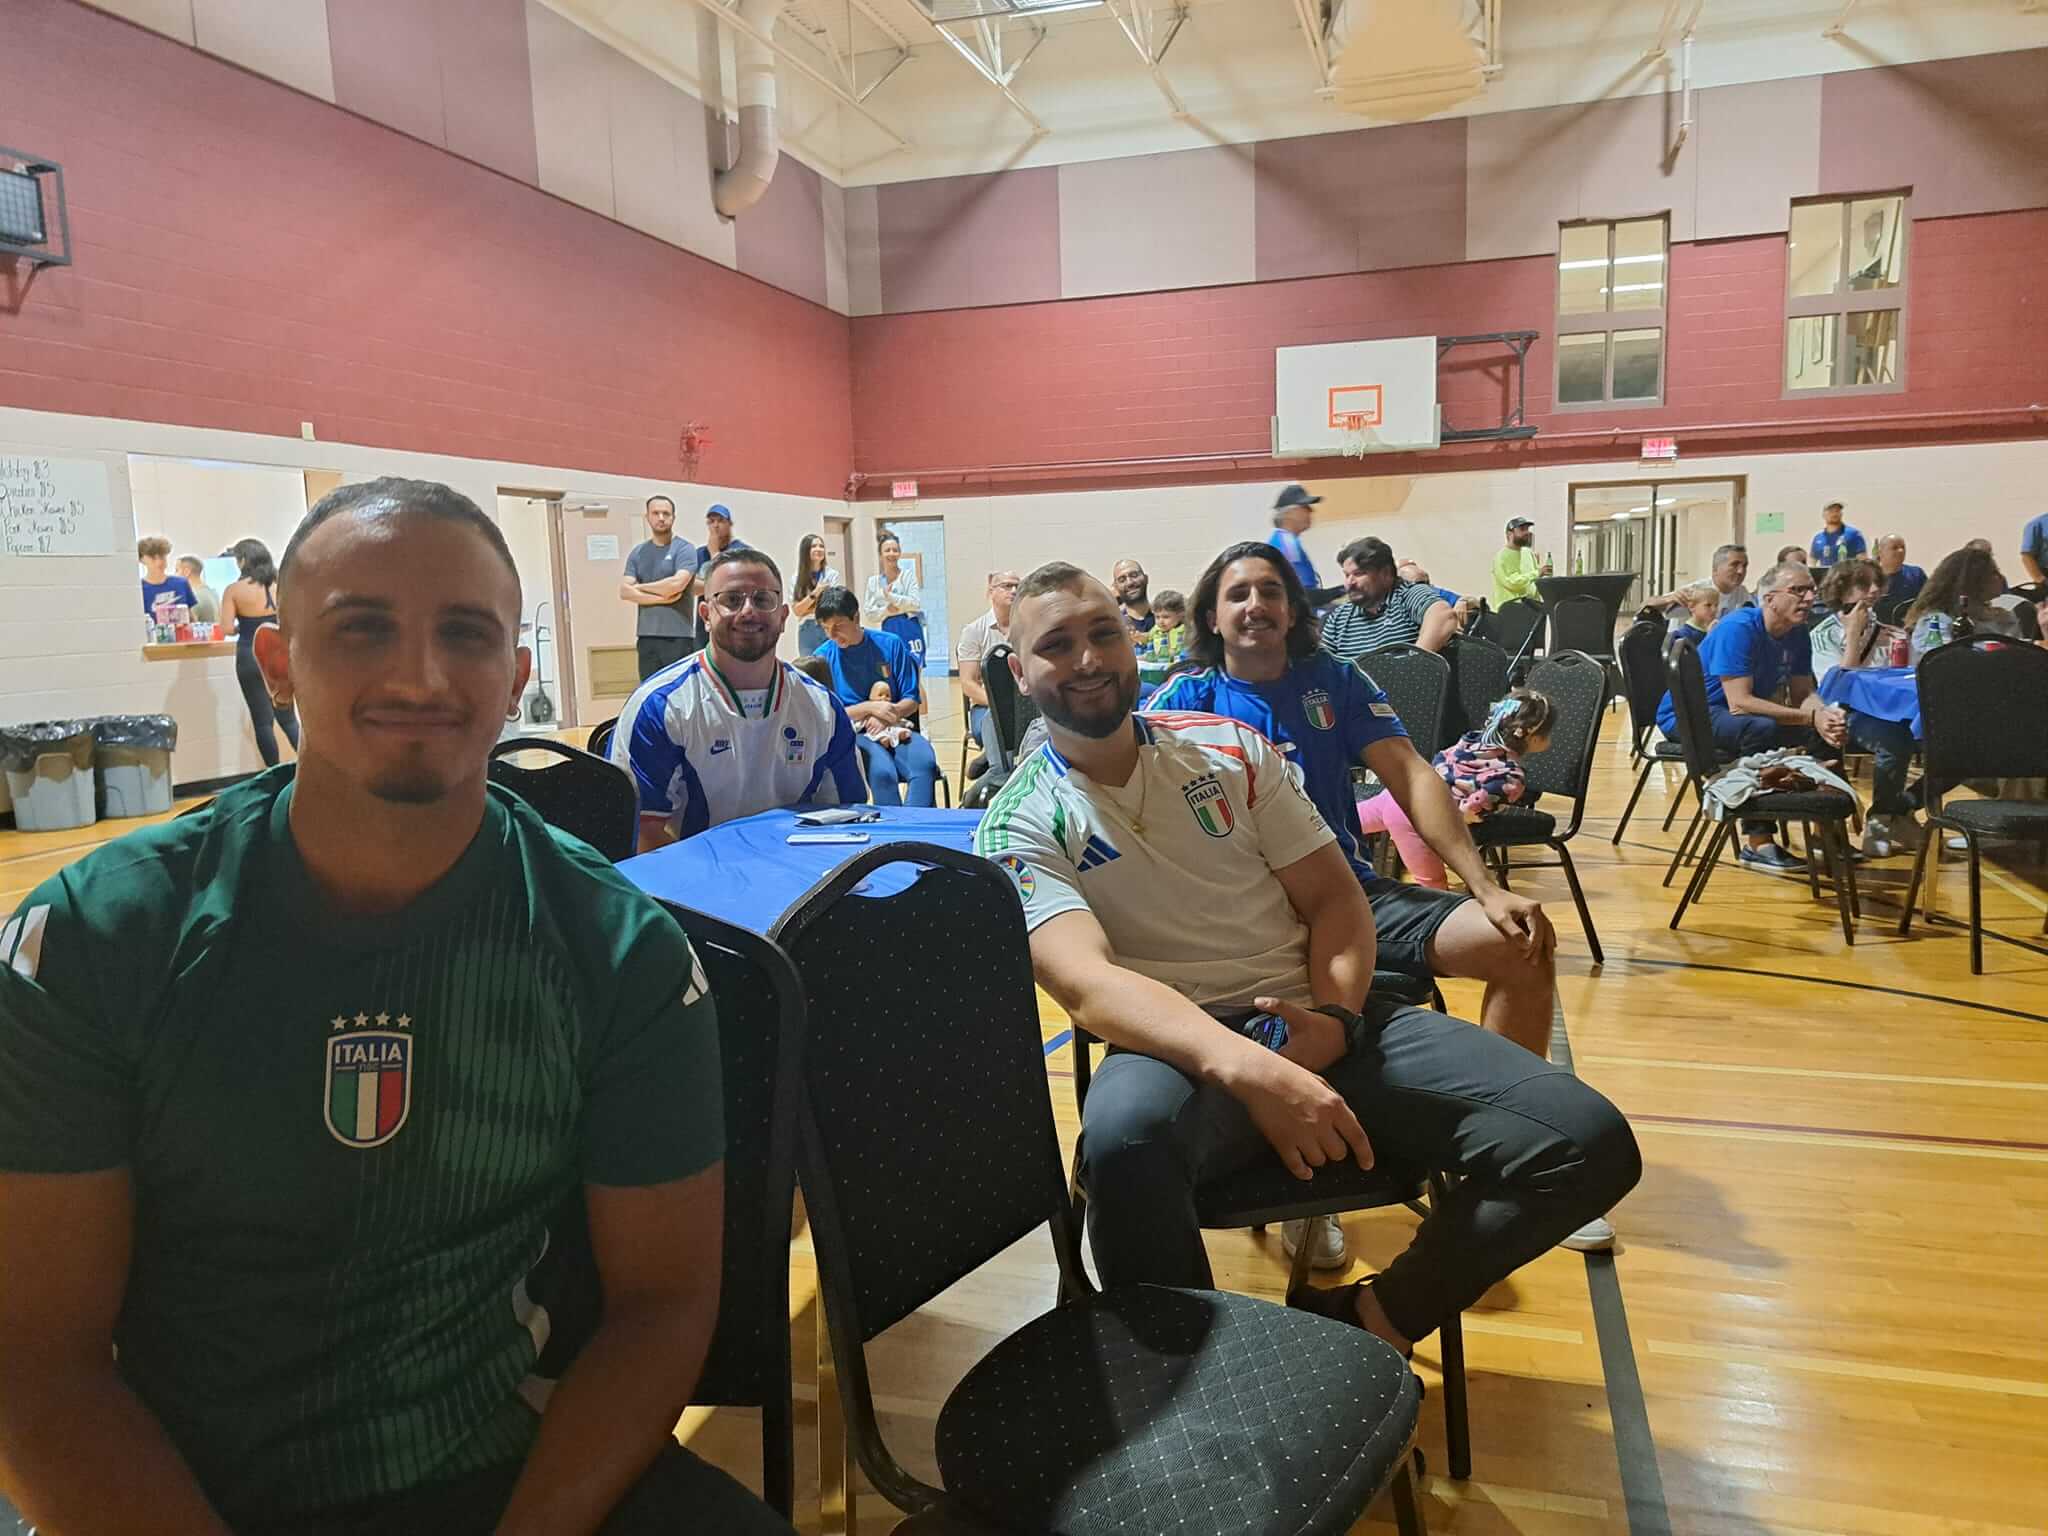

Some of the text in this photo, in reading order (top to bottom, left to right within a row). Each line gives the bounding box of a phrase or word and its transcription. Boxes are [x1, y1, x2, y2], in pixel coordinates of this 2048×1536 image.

[908, 639, 921, 653] 10
[1189, 786, 1221, 805] ITALIA
[335, 1042, 403, 1063] ITALIA
